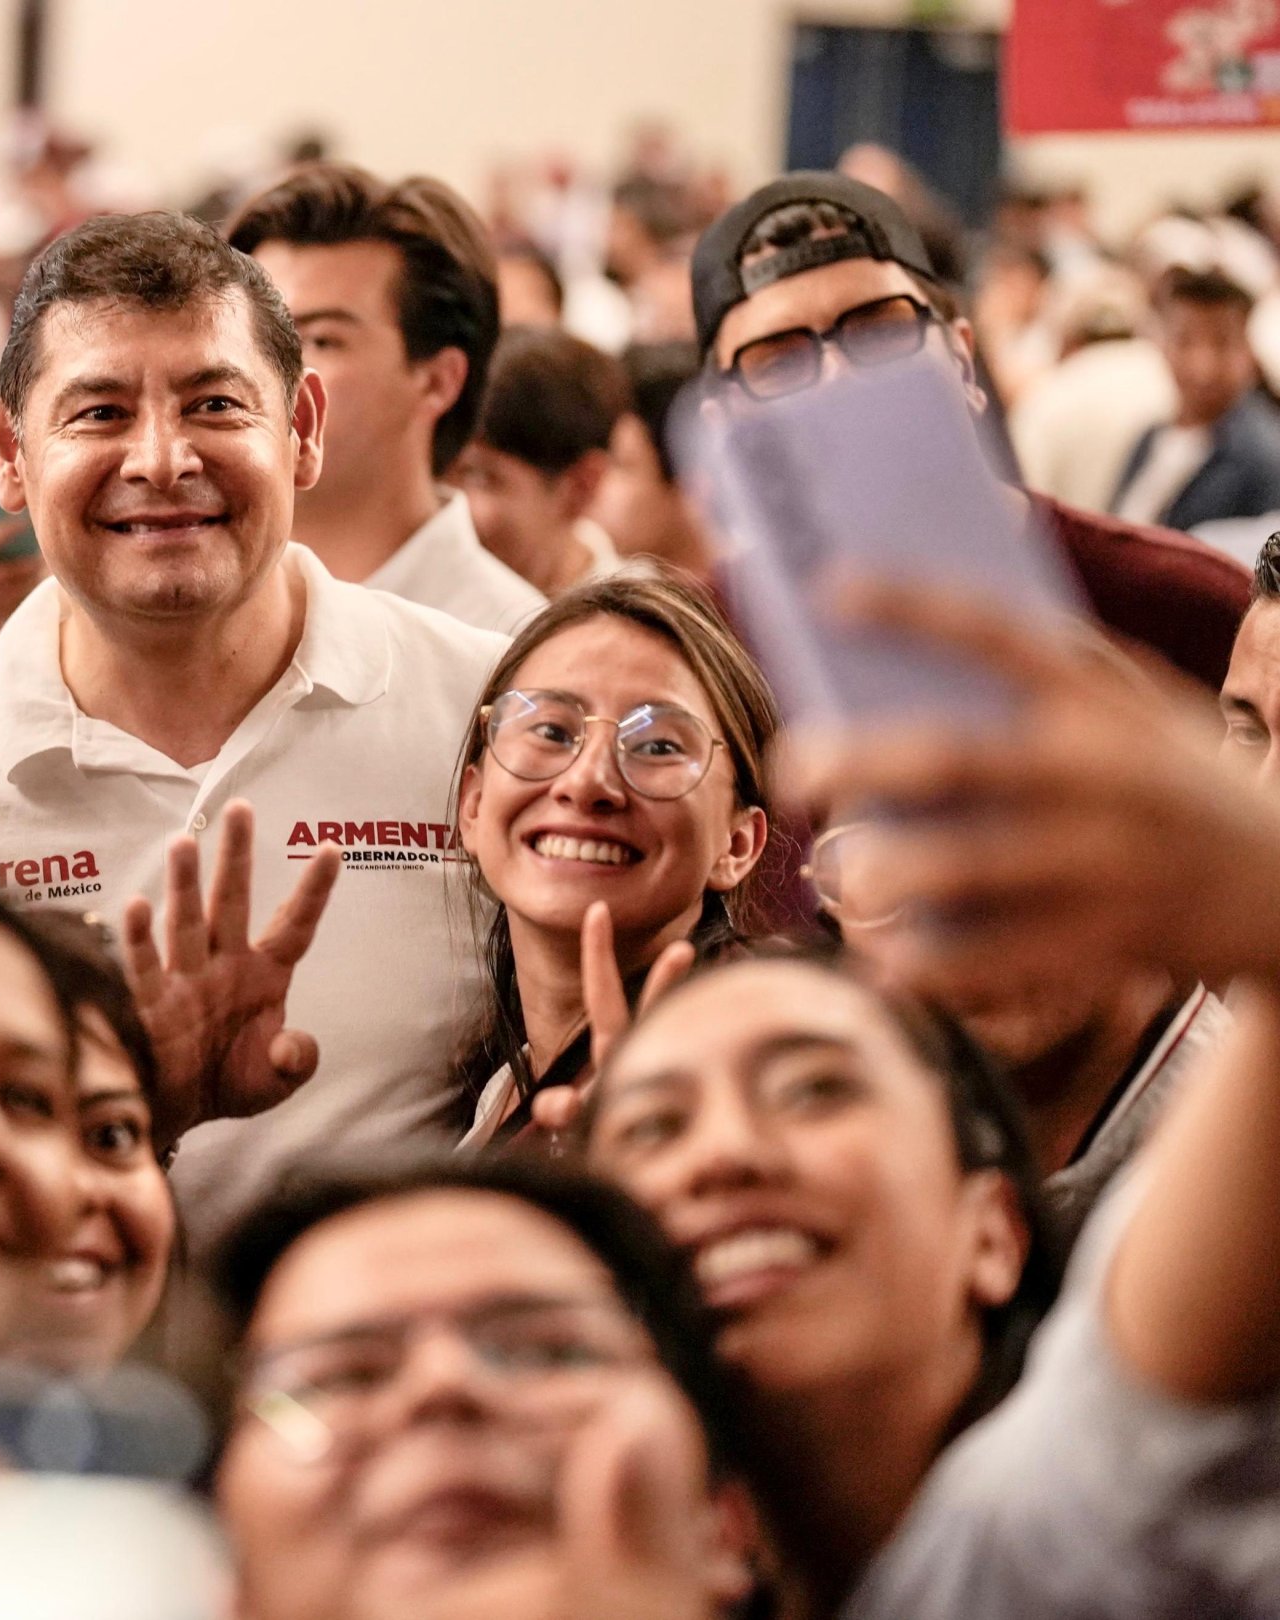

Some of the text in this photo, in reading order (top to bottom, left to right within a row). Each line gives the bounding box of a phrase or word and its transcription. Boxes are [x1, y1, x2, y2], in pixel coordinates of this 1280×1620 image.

[341, 851, 439, 863] OBERNADOR
[25, 889, 42, 902] de
[48, 882, 101, 899] México
